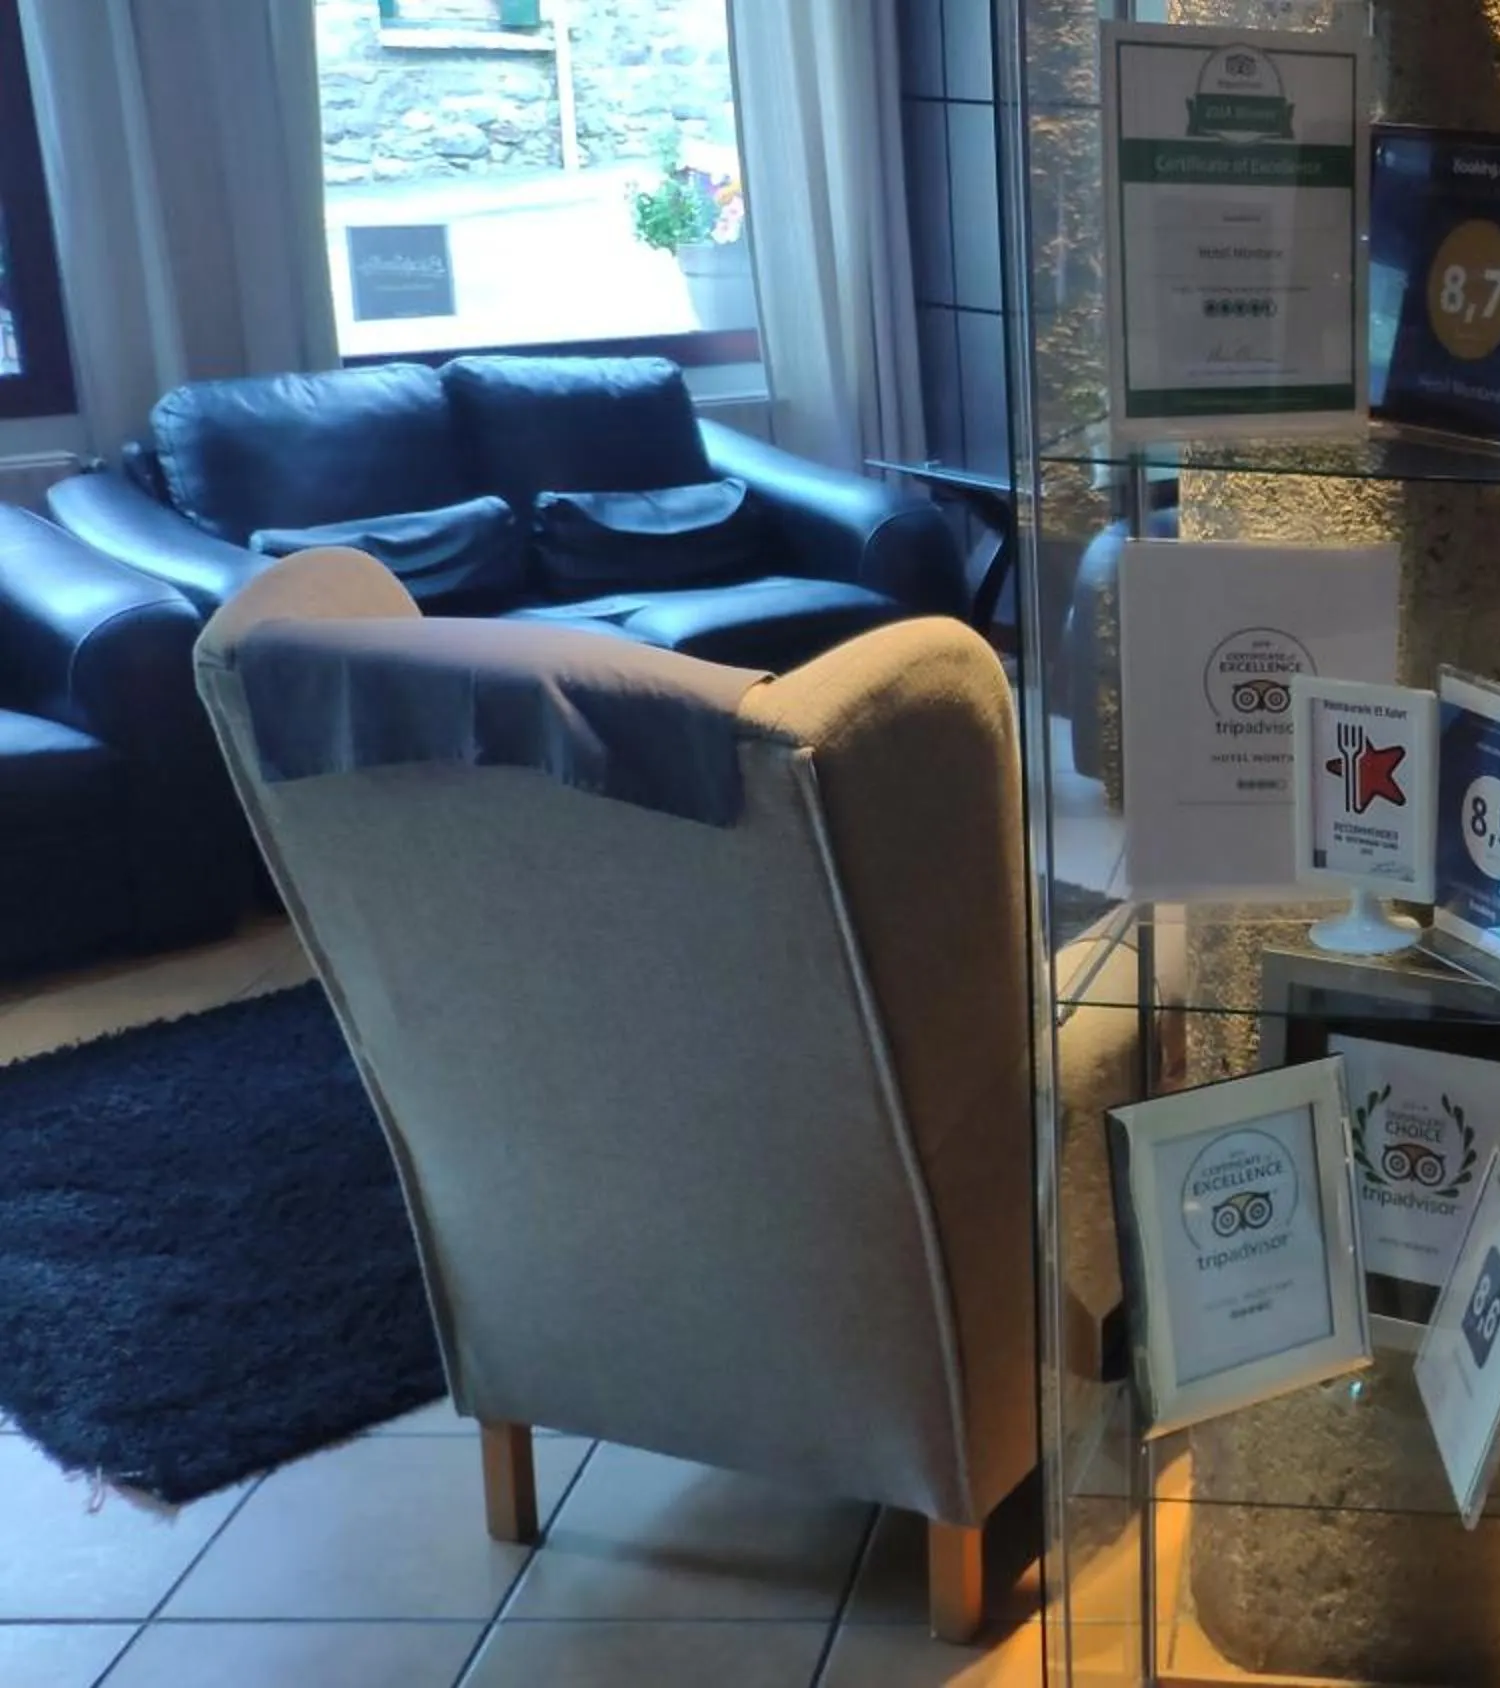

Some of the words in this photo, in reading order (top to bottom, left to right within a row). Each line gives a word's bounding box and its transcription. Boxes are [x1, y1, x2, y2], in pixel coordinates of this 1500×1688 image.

[1219, 661, 1303, 673] EXCELLENCE
[1214, 718, 1294, 737] tripadviso
[1385, 1120, 1441, 1143] CHOICE
[1193, 1160, 1283, 1196] EXCELLENCE
[1363, 1185, 1456, 1216] tripadvisor
[1196, 1234, 1289, 1271] tripadvisor
[1473, 1274, 1500, 1341] 8,6
